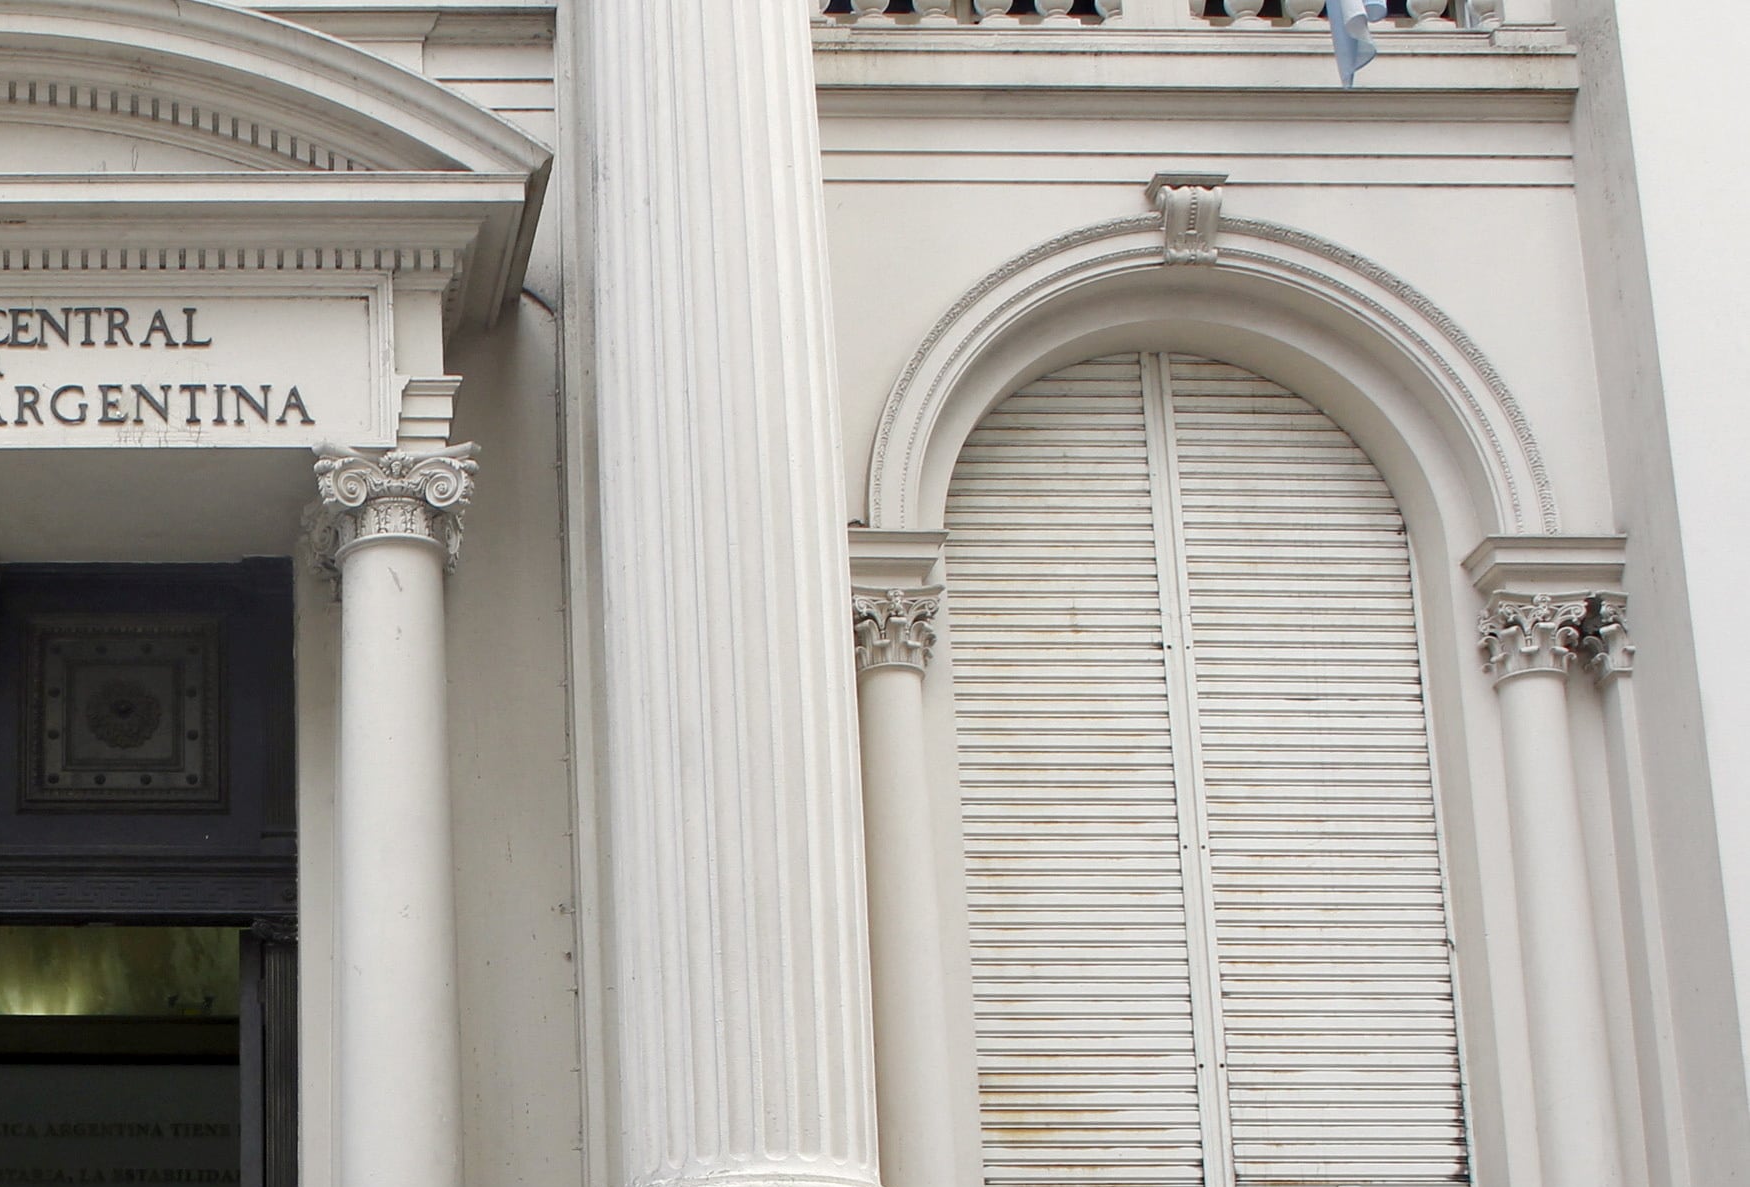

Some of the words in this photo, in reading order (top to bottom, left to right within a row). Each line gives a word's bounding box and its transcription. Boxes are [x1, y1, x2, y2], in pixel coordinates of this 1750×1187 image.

[44, 1122, 163, 1137] ARGENTINA
[171, 1122, 231, 1137] TIENE
[80, 1168, 106, 1182] LA
